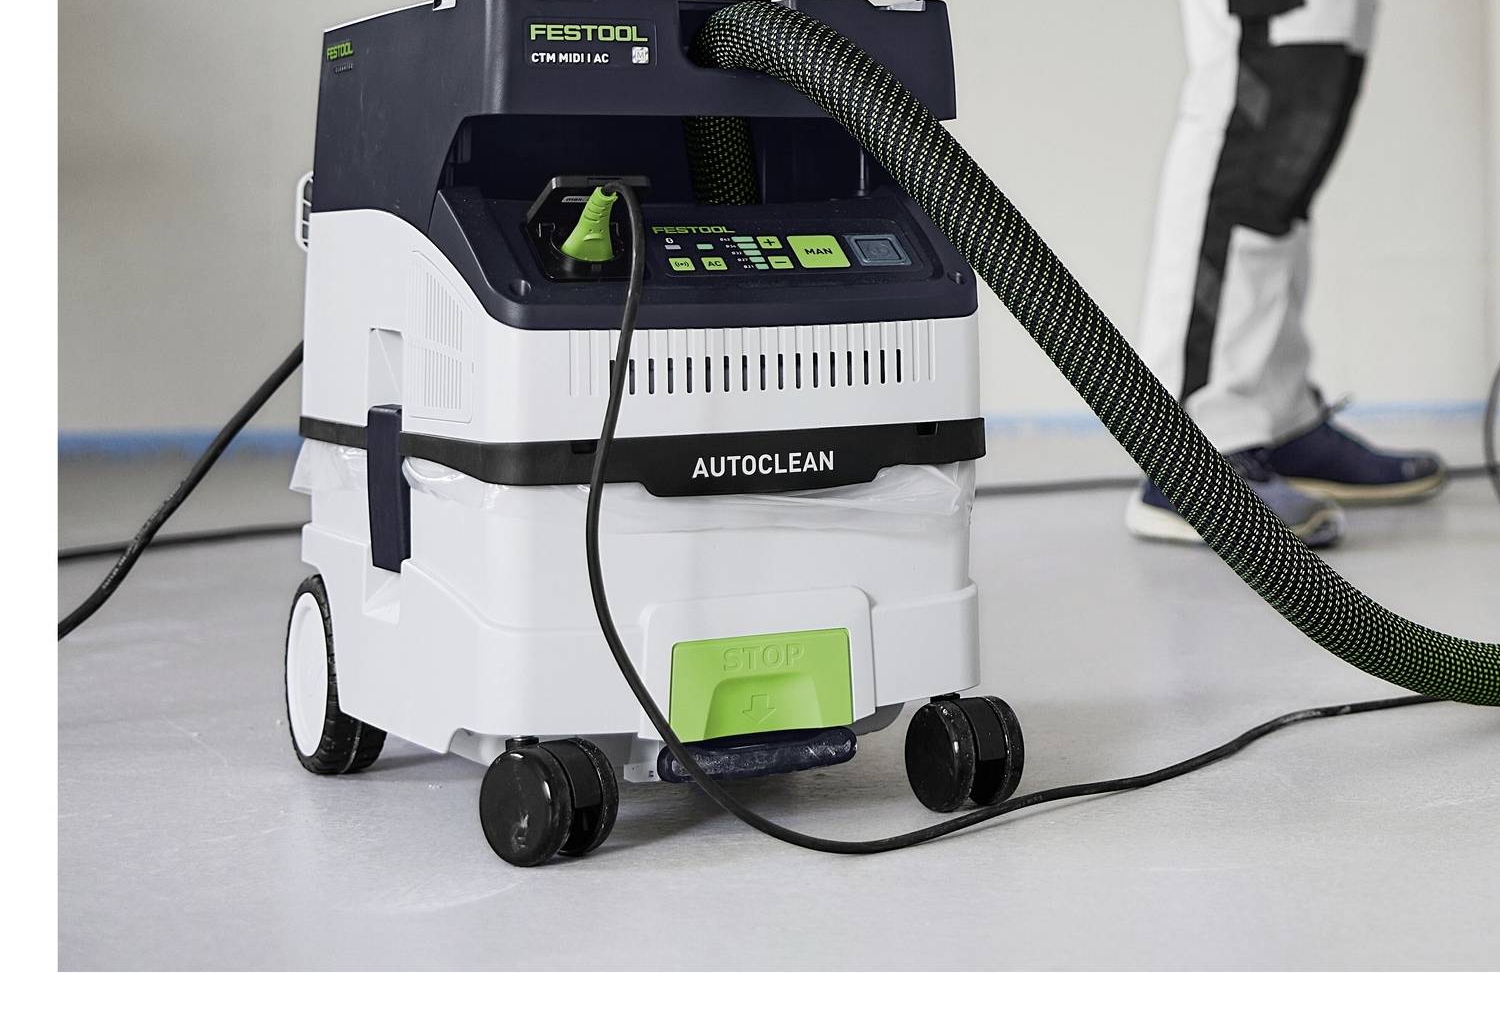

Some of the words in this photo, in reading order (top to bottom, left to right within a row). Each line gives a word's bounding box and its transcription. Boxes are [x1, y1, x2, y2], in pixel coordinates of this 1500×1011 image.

[530, 24, 648, 42] FESTOOL
[327, 41, 353, 61] FESTOOL
[531, 52, 556, 63] CTM
[558, 53, 584, 63] MIDI
[593, 53, 610, 63] AC
[652, 226, 736, 234] FESTOOL
[692, 450, 834, 478] AUTOCLEAN
[723, 643, 805, 670] STOP
